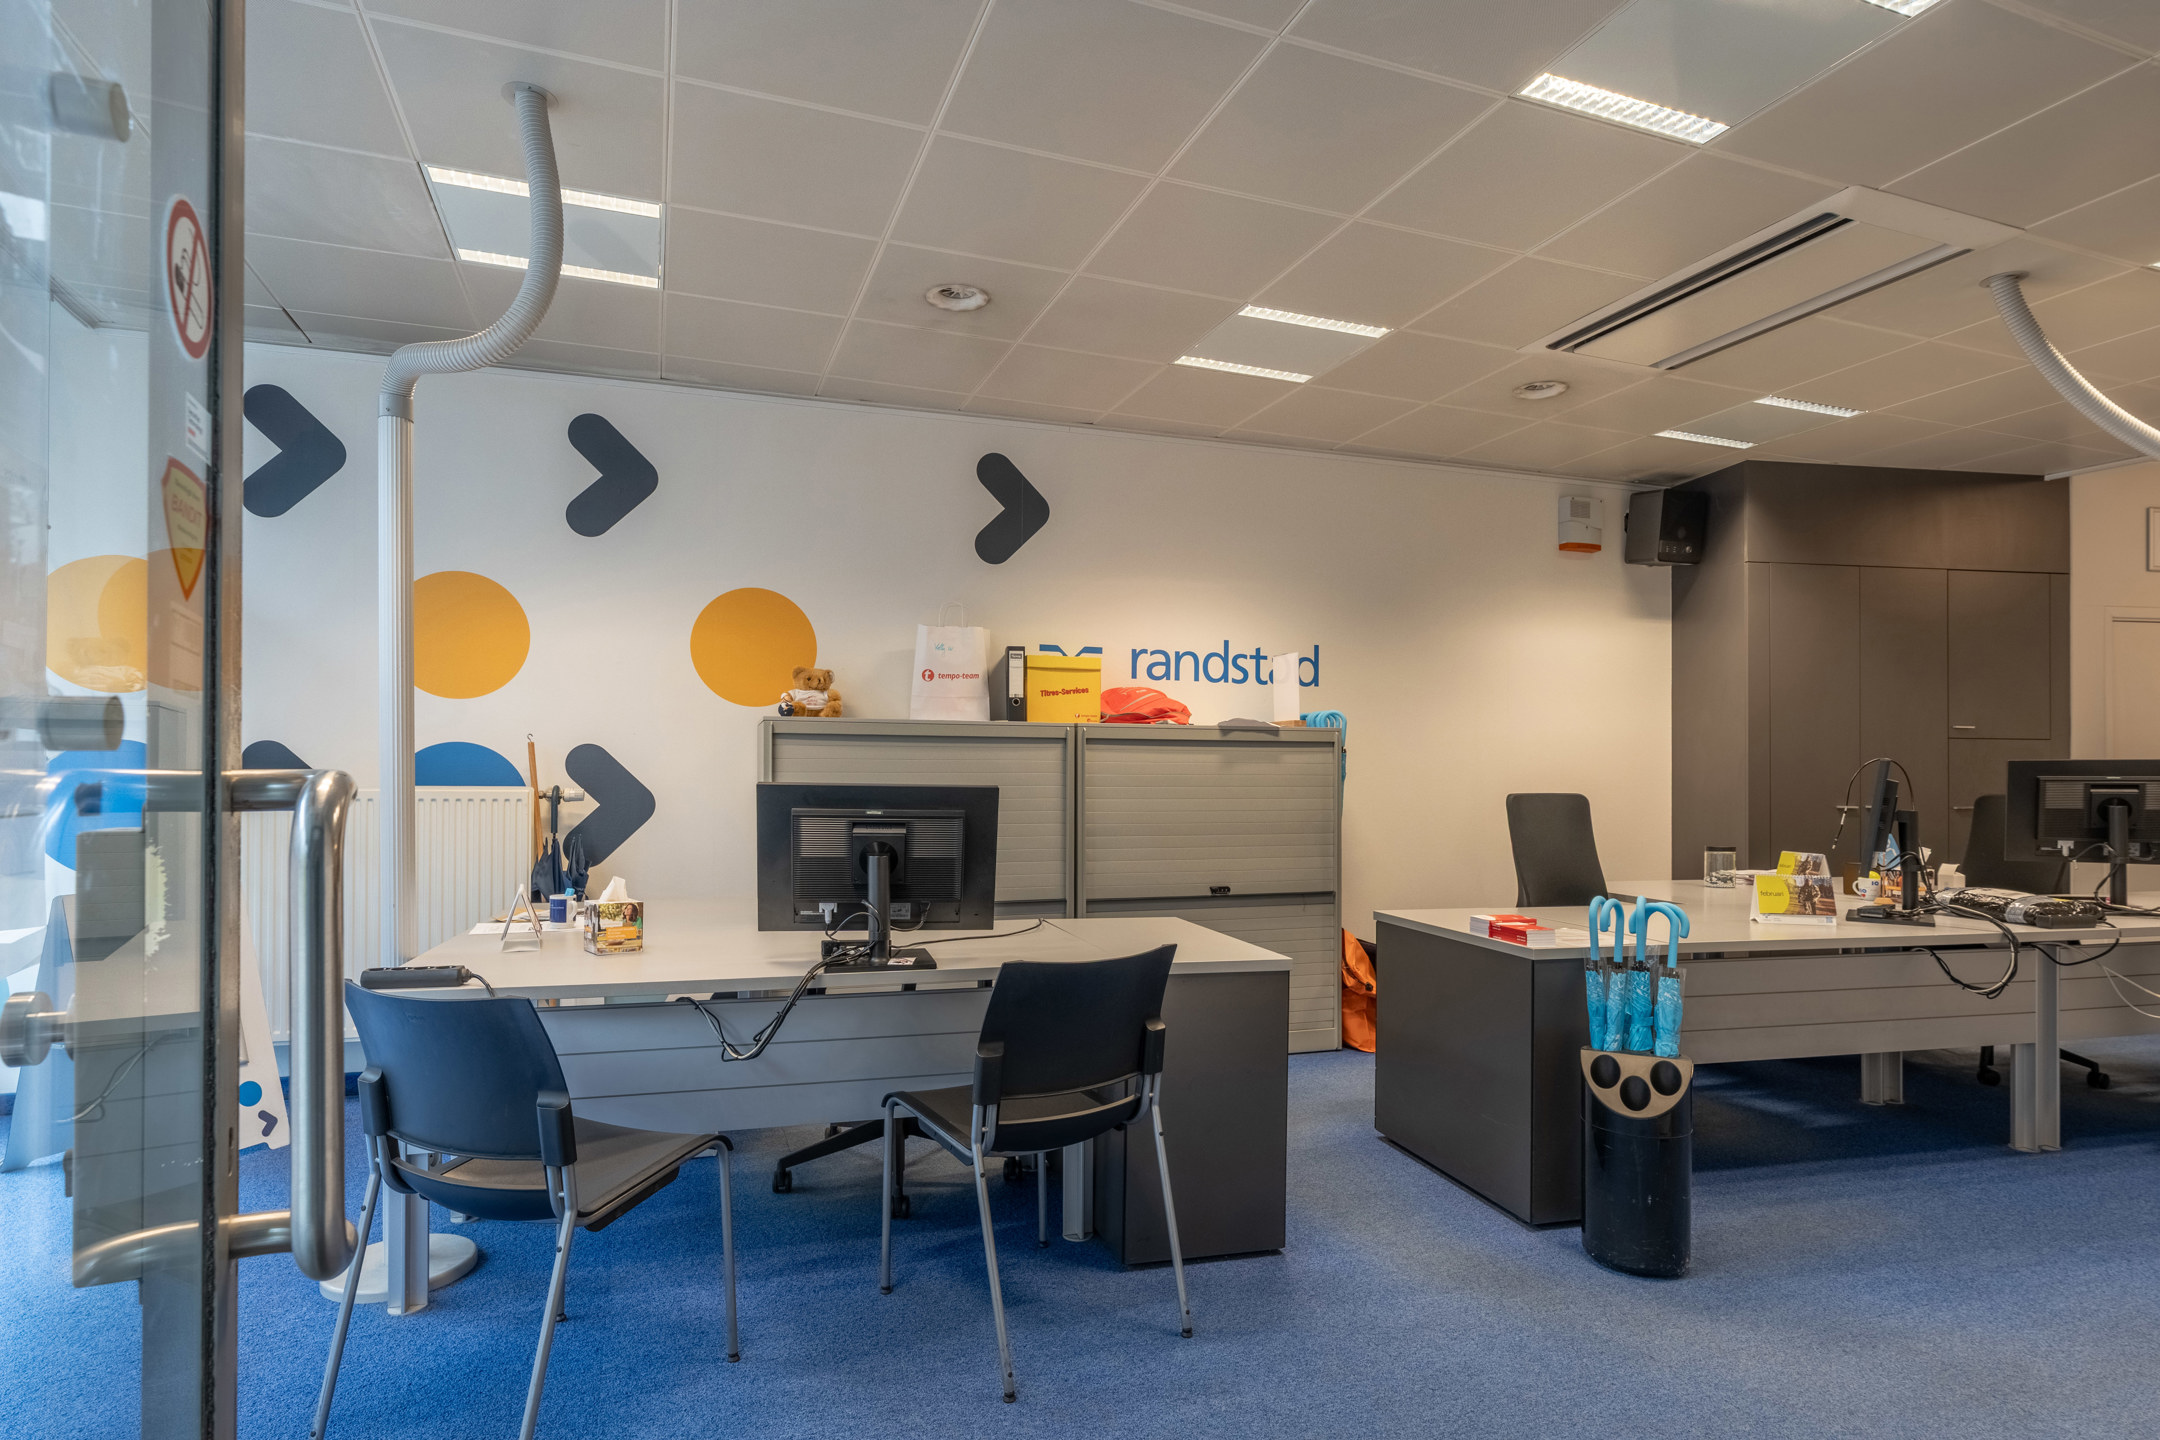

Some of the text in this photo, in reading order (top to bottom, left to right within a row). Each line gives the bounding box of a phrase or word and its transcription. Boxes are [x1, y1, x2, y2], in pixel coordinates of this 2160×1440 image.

[1131, 639, 1319, 687] randstd
[938, 672, 979, 681] tempo-team
[1040, 687, 1089, 697] Titres-Services
